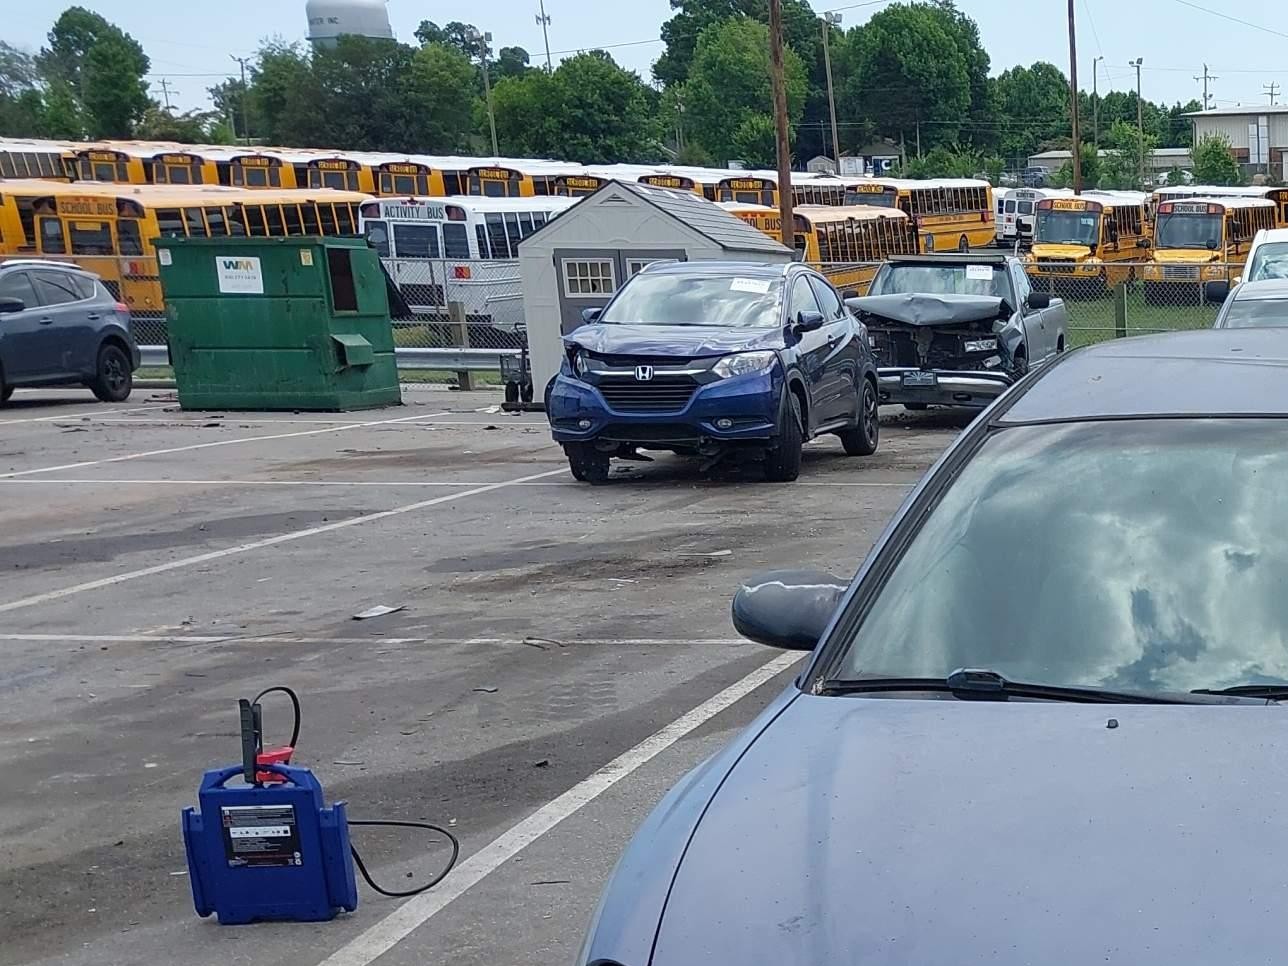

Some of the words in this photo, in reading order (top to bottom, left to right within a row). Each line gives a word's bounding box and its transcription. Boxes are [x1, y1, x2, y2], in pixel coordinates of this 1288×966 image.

[62, 202, 94, 214] SCHOOL
[97, 204, 114, 215] BUS
[1053, 201, 1073, 210] SCHOOL
[1075, 202, 1086, 210] BUS
[1175, 204, 1194, 213] SCHOOL
[1195, 205, 1208, 213] BUS
[385, 206, 421, 218] ACTIVITY
[427, 207, 444, 219] BUS
[765, 218, 781, 230] BUS
